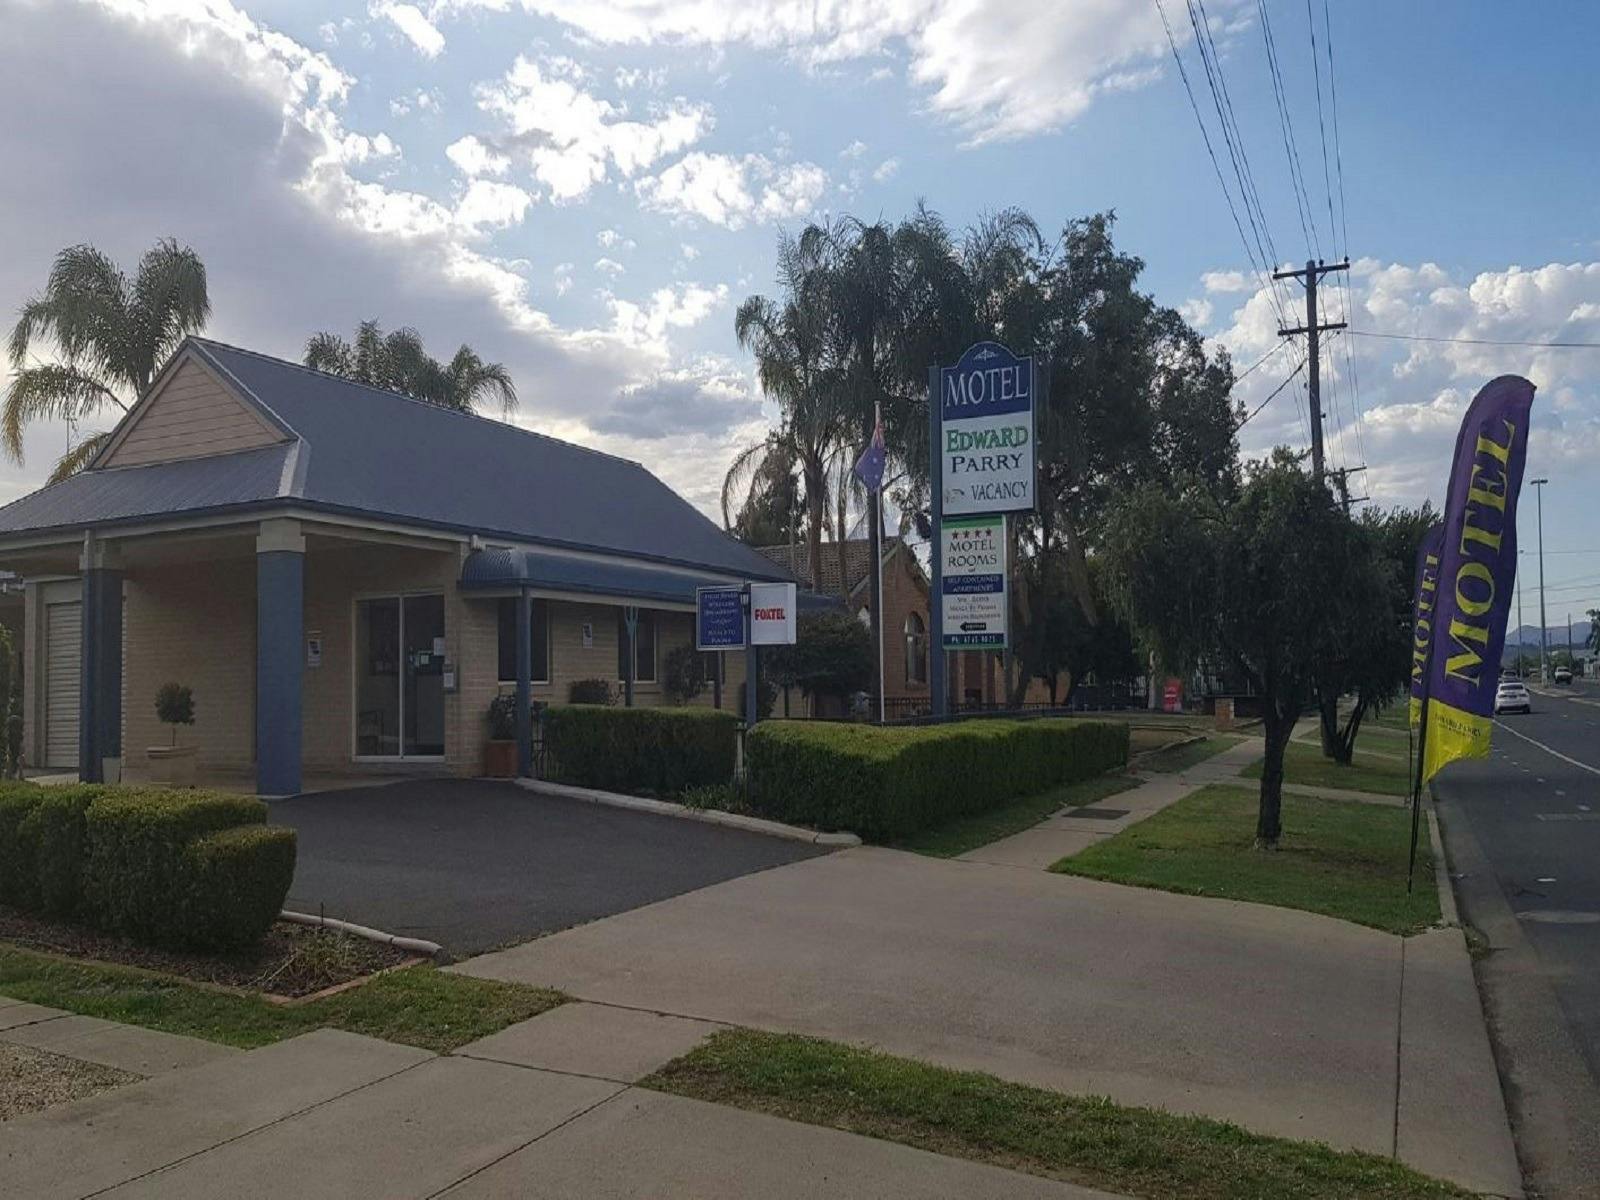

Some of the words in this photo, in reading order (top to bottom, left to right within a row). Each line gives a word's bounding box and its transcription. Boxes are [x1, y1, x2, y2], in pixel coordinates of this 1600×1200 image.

[945, 365, 1029, 407] MOTEL
[945, 425, 1029, 453] EDWARD
[951, 453, 1023, 473] PARRY
[971, 480, 1028, 501] VACANCY
[949, 539, 996, 552] MOTEL
[1445, 419, 1515, 688] MOTEL
[948, 554, 997, 567] ROOMS
[754, 607, 786, 621] FOXTEL
